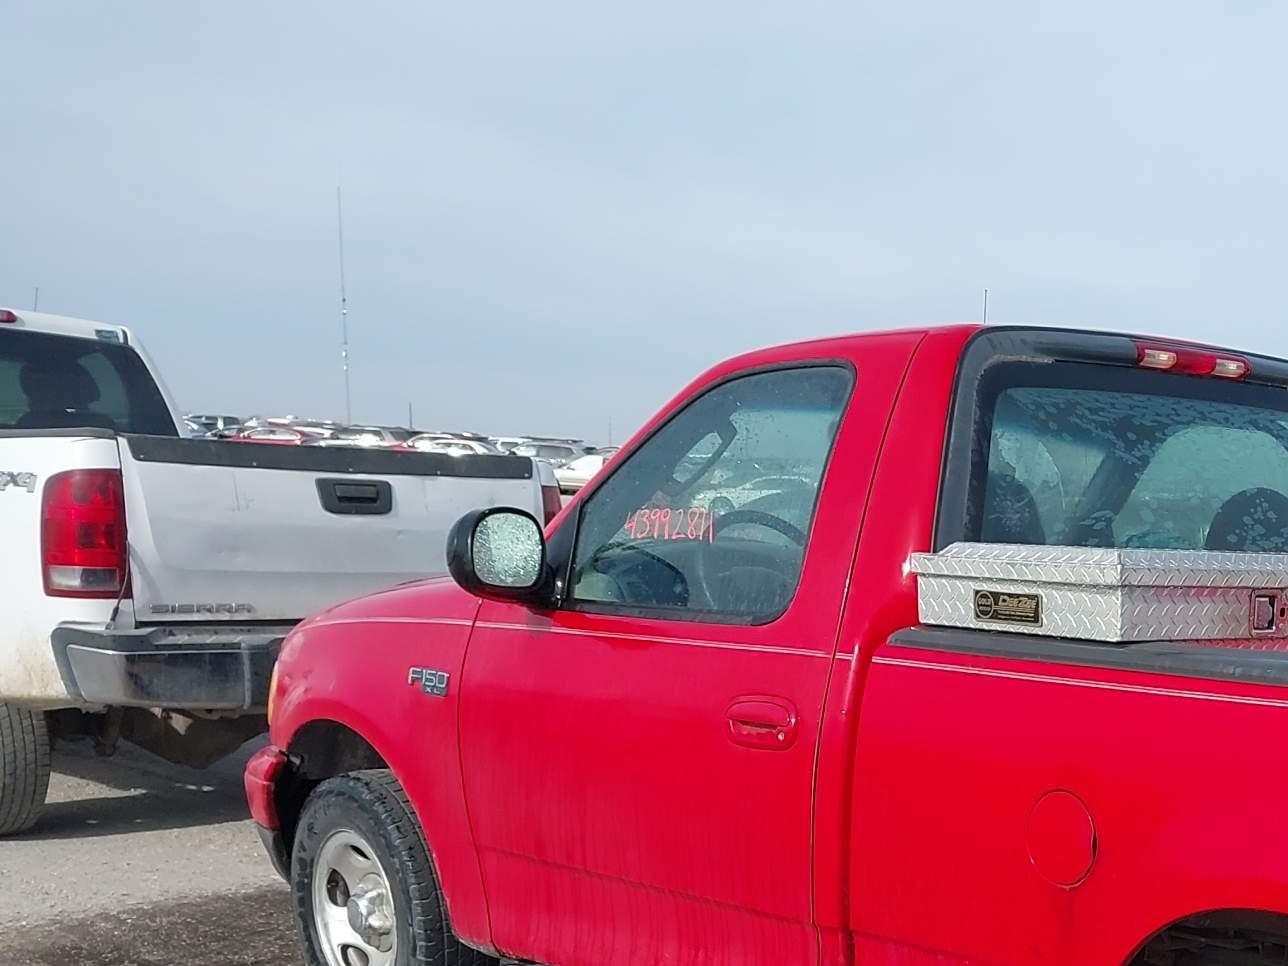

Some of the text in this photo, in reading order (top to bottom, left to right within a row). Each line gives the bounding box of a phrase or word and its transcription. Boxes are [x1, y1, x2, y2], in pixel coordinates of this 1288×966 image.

[624, 507, 714, 544] 43992811
[150, 602, 257, 615] SIERRA
[424, 686, 441, 694] XL
